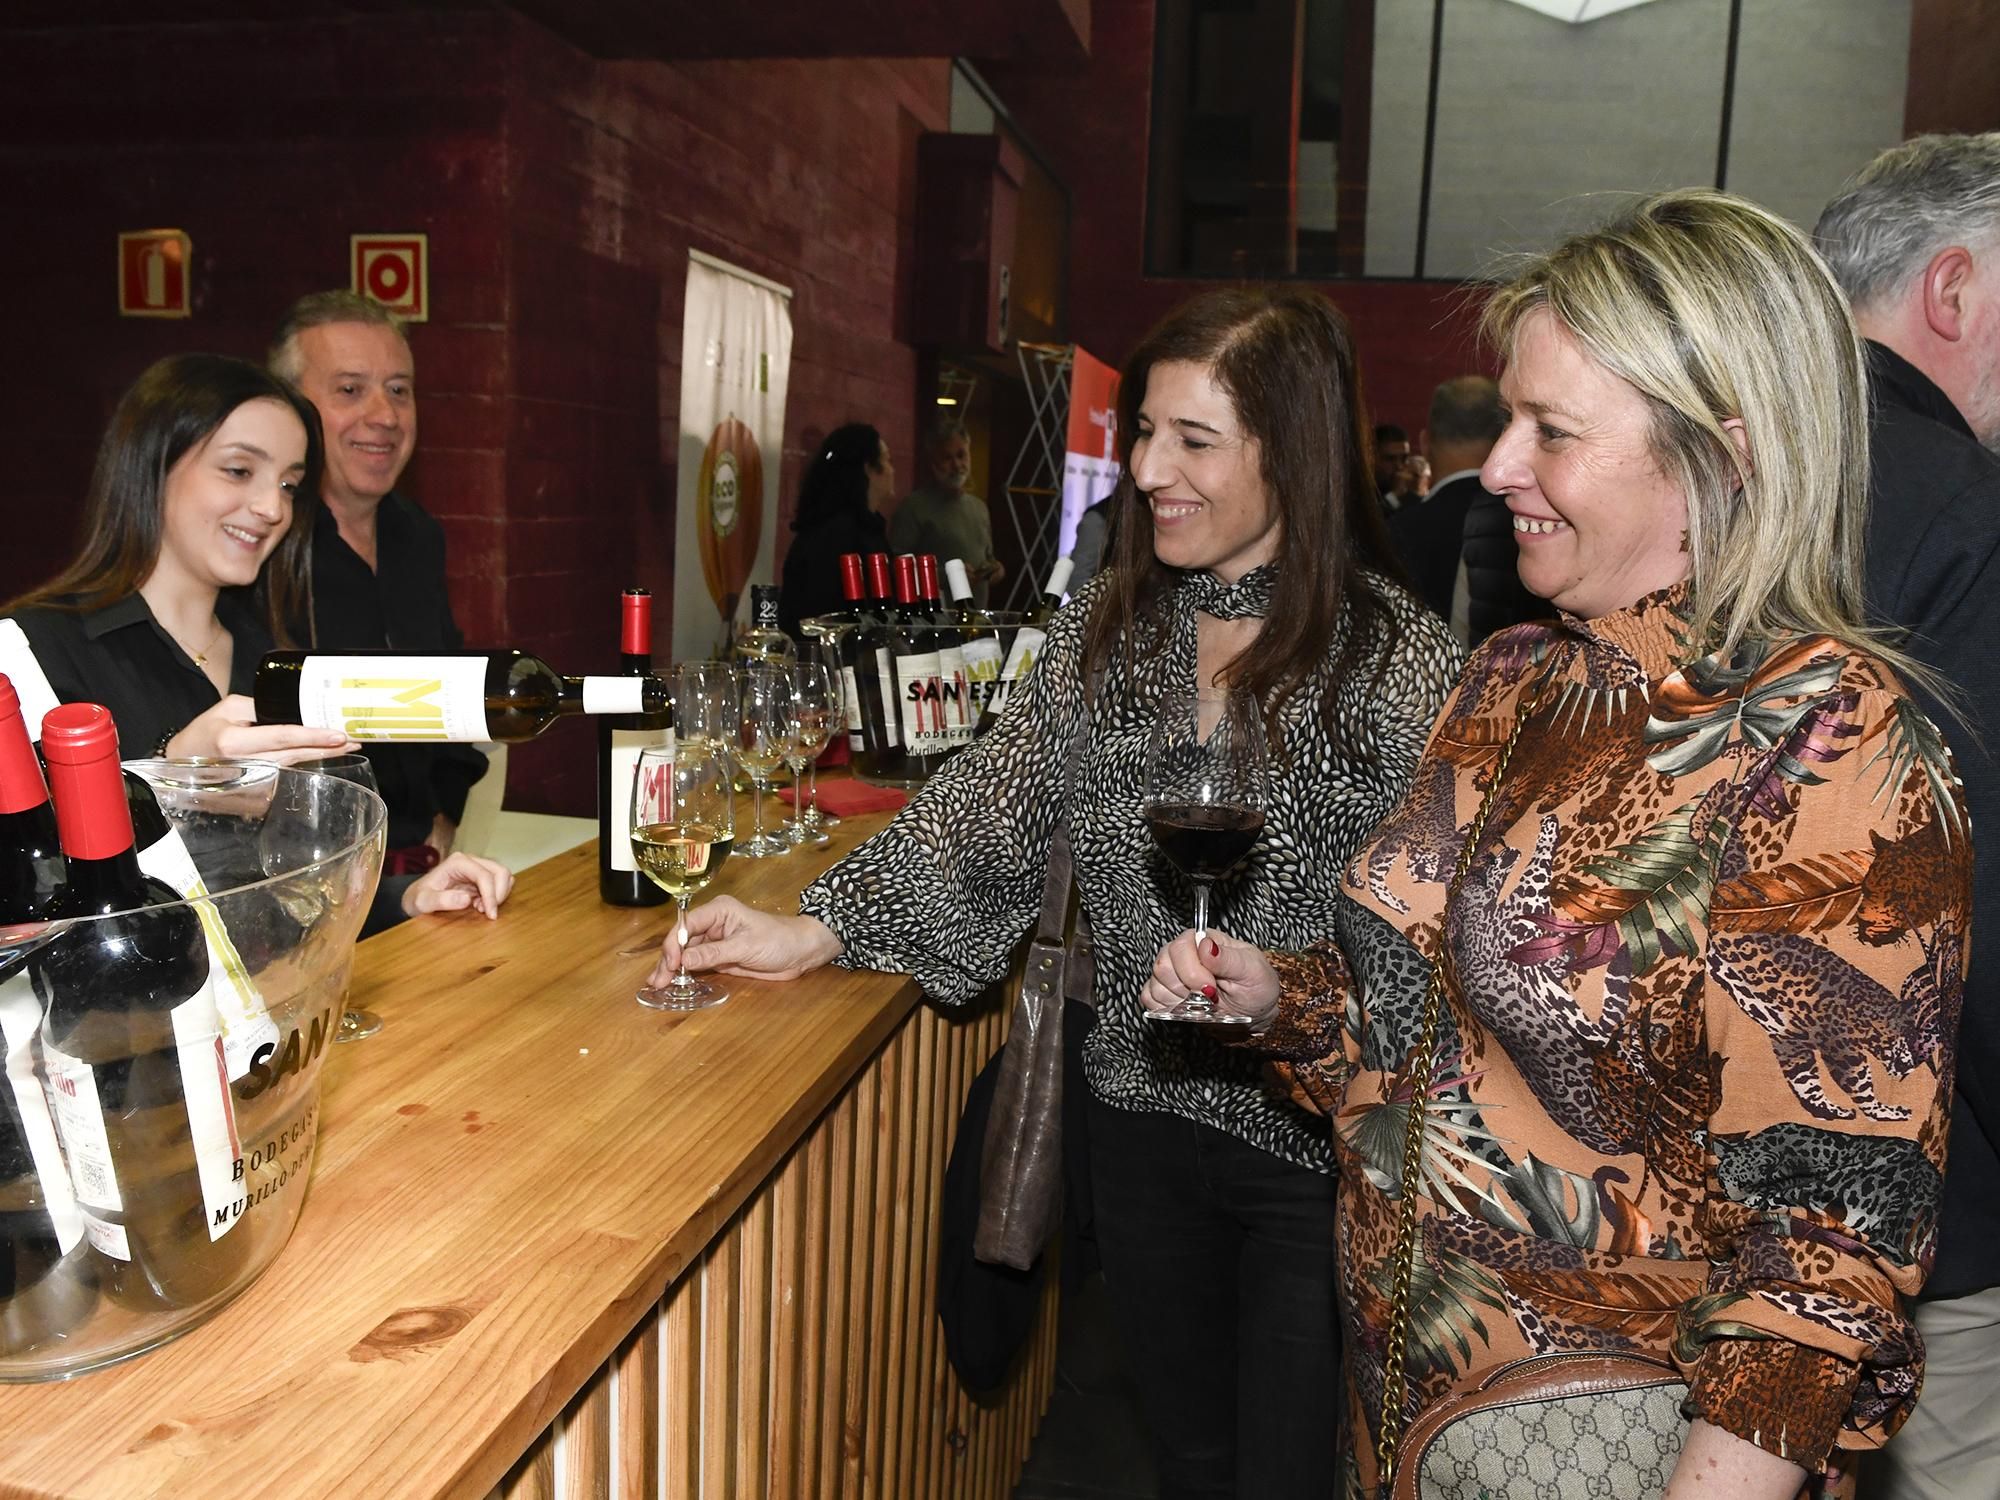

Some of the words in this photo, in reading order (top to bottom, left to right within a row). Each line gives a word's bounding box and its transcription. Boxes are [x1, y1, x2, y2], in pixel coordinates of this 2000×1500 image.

[760, 600, 777, 618] 22
[907, 682, 960, 703] SAN
[915, 730, 971, 739] BODEGAS
[239, 1008, 331, 1100] SAN
[231, 1106, 313, 1182] BODEGAS
[213, 1170, 288, 1226] MURILLO
